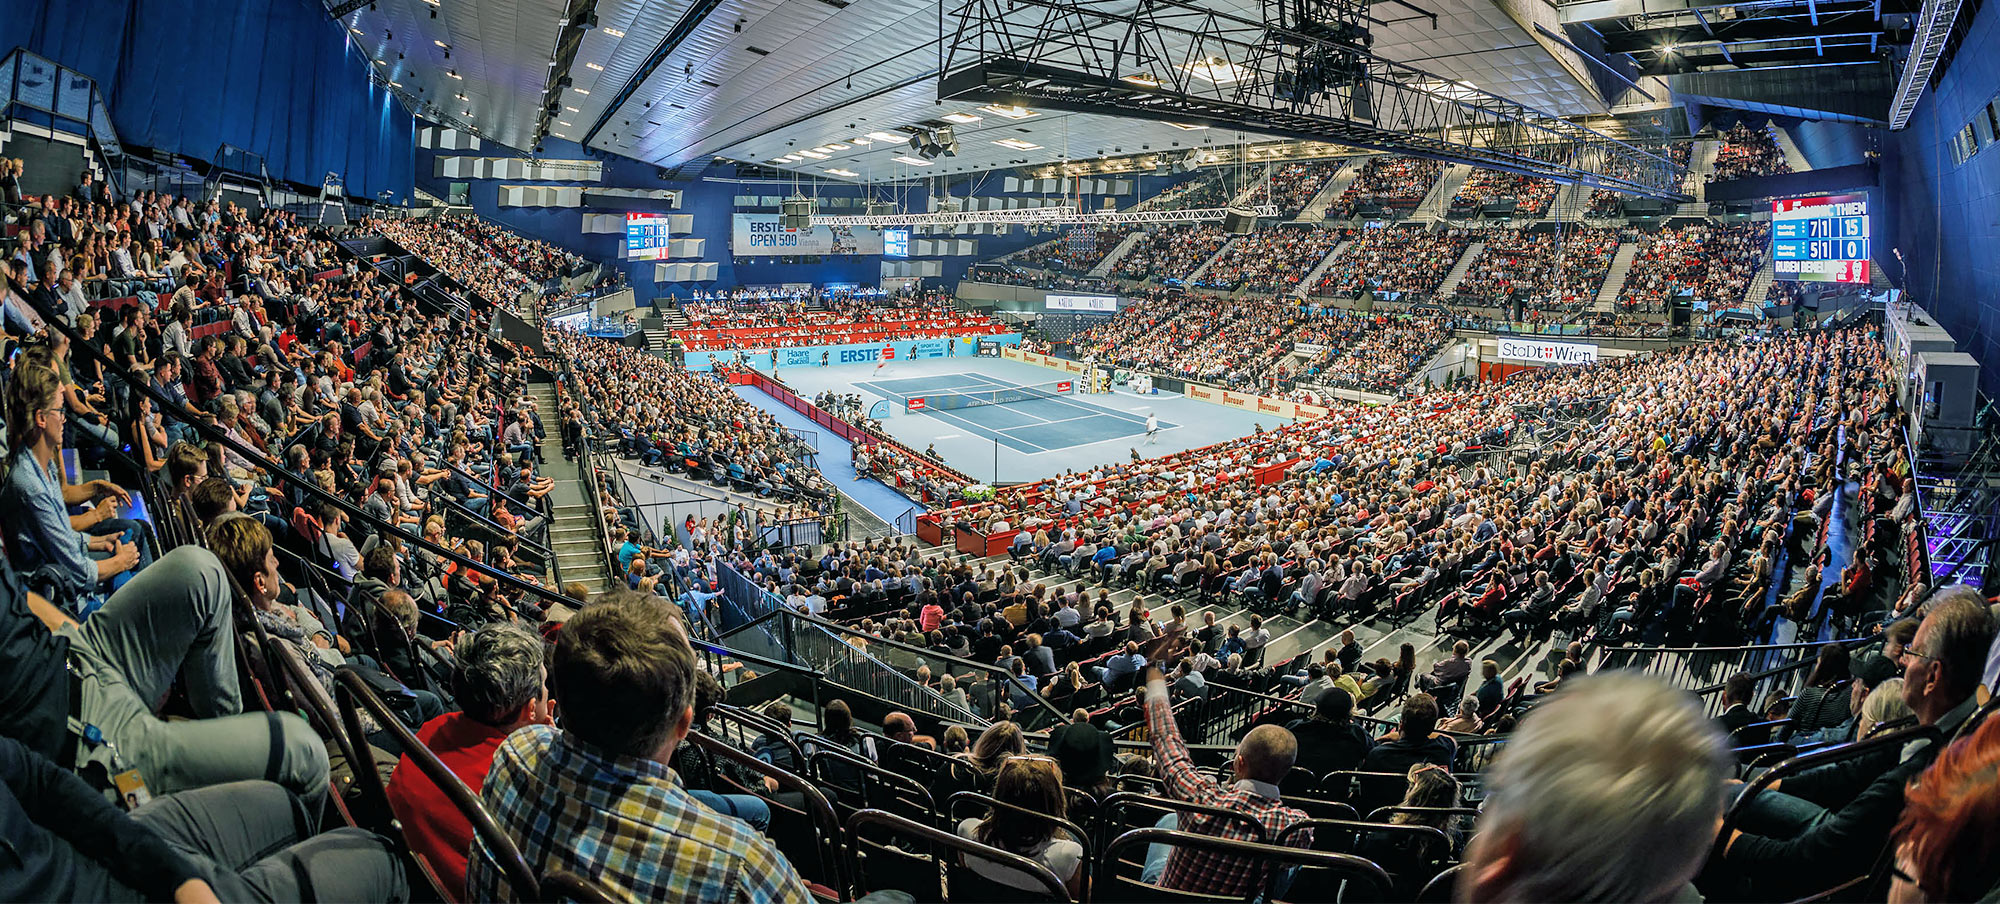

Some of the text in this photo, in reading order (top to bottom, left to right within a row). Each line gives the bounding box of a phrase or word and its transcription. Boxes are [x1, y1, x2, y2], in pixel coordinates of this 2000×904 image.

[1836, 202, 1866, 216] THIEM
[750, 222, 784, 232] ERSTE
[1810, 220, 1858, 236] 7 1 15
[750, 234, 797, 246] OPEN 500
[1810, 241, 1857, 258] 5 1 0
[1776, 261, 1800, 272] RUBEN
[841, 348, 879, 362] ERSTE
[1555, 346, 1591, 362] Wien
